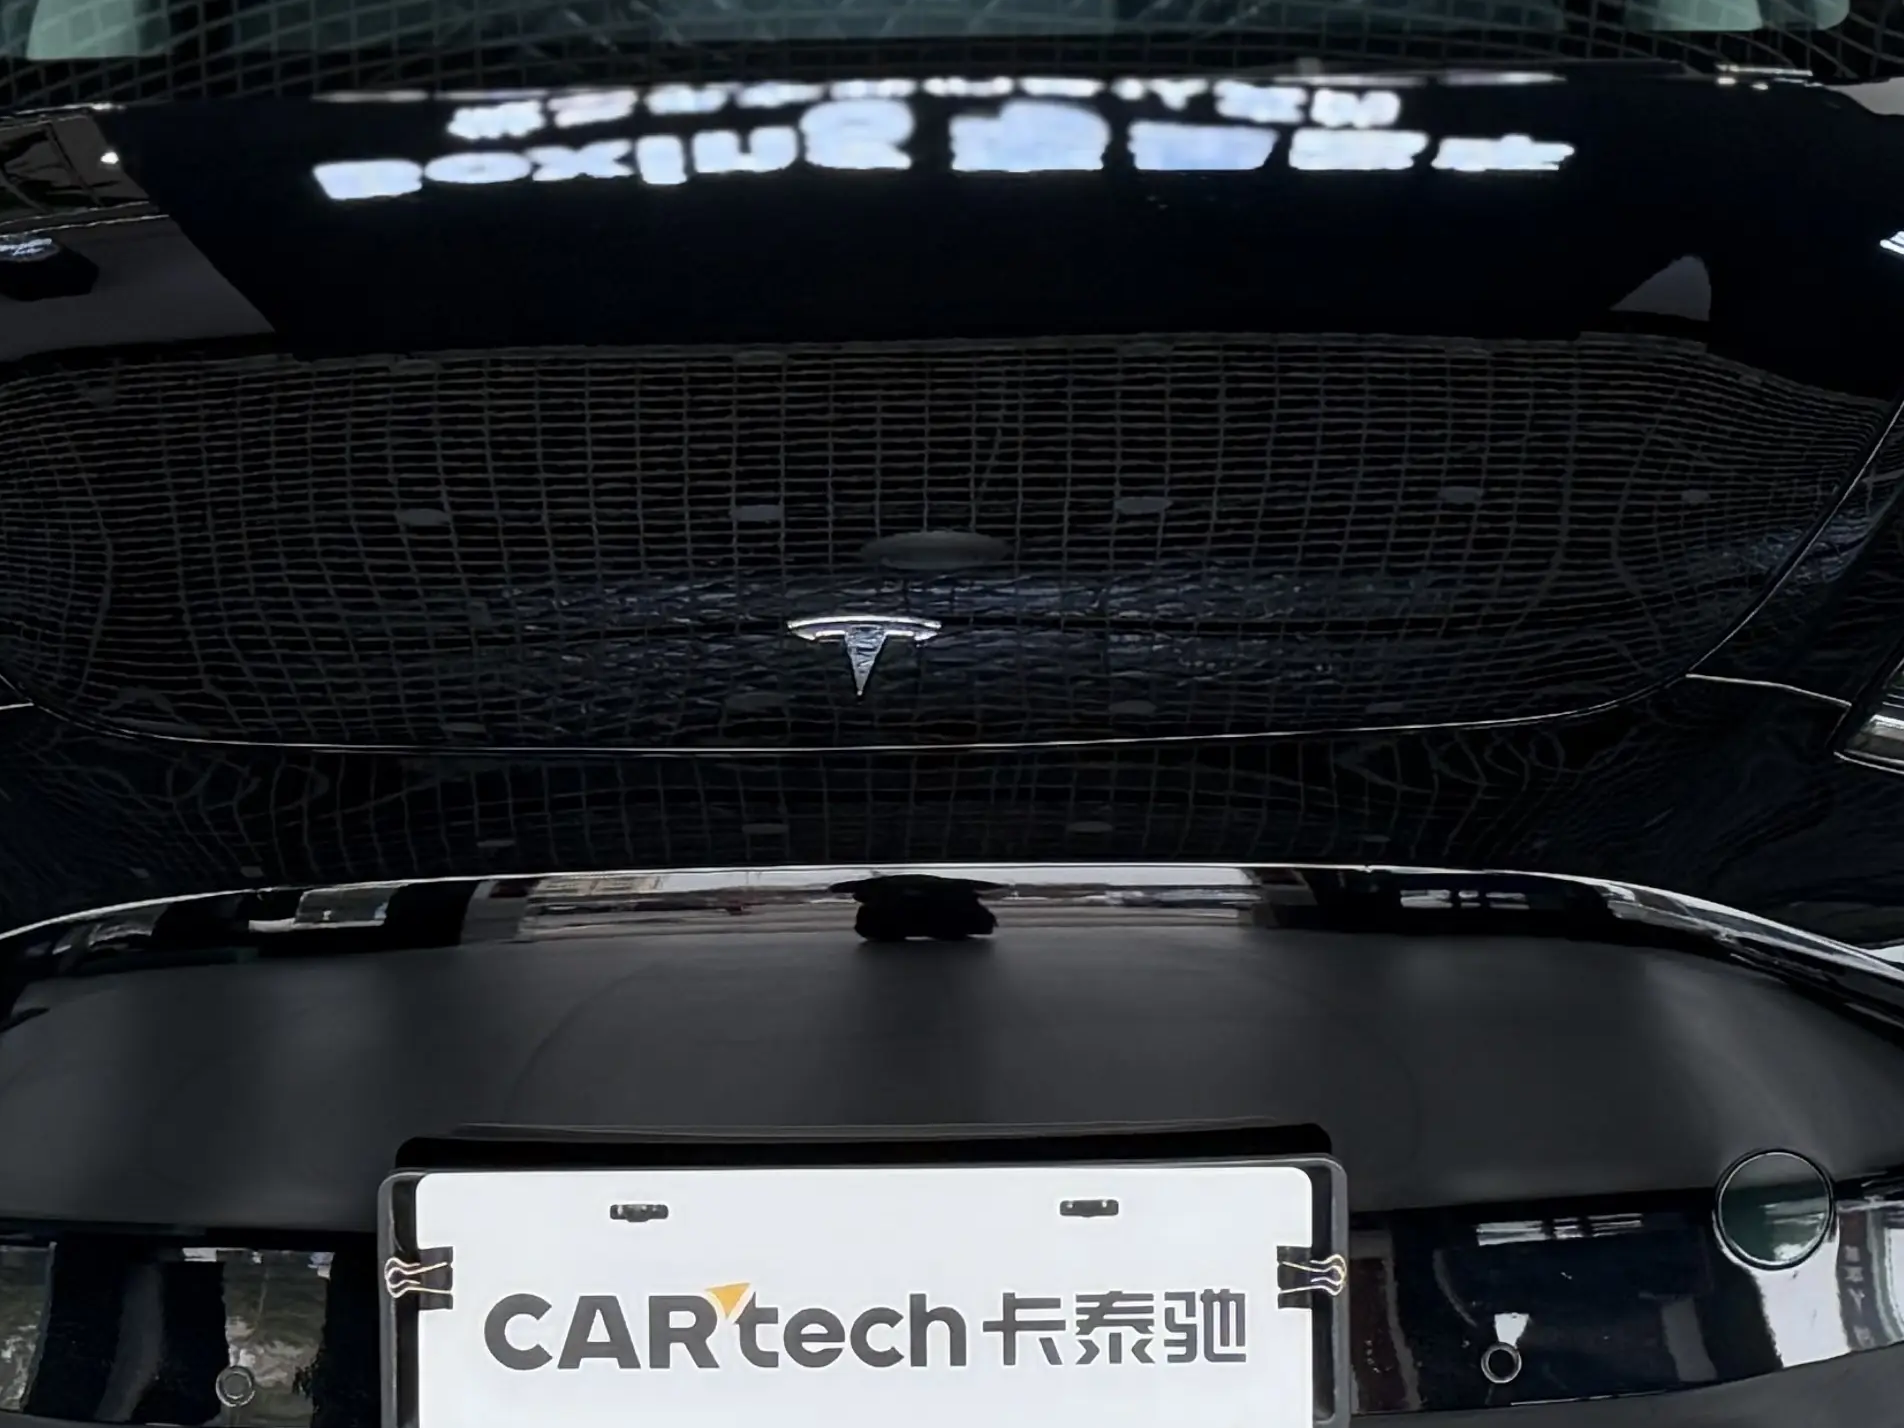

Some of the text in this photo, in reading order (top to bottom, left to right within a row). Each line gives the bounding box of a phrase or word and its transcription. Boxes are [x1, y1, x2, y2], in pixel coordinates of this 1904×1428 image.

[483, 1288, 1247, 1371] CARtech 卡泰驰
